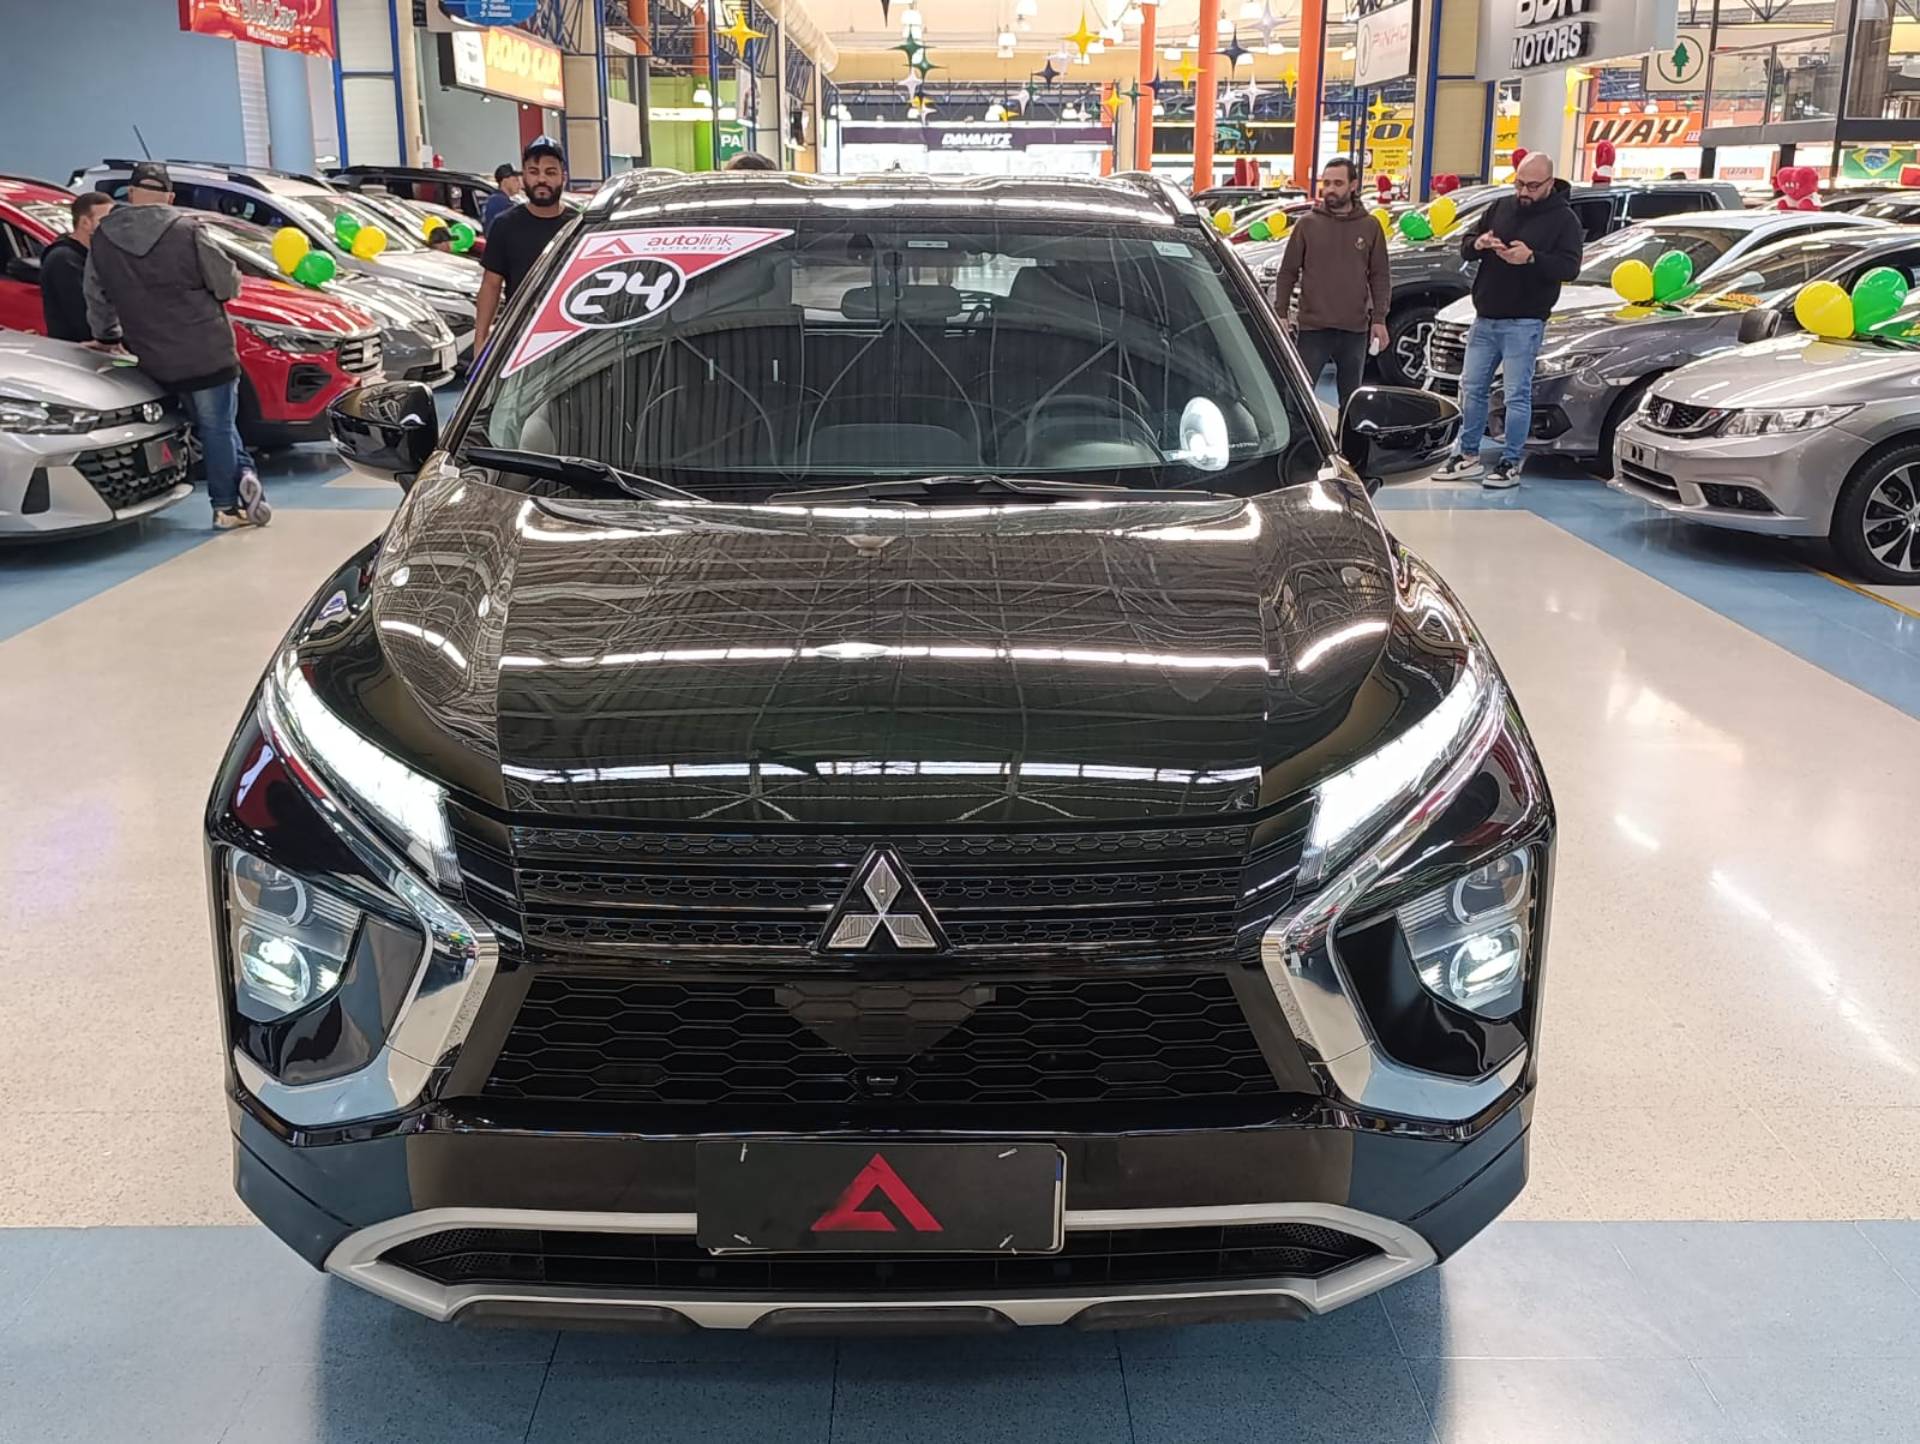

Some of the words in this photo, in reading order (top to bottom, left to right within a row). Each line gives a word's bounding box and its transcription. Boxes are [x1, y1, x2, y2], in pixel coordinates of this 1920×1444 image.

[1511, 22, 1583, 69] MOTORS
[1586, 117, 1690, 144] WAY
[646, 233, 735, 246] autolink
[569, 270, 674, 316] 24
